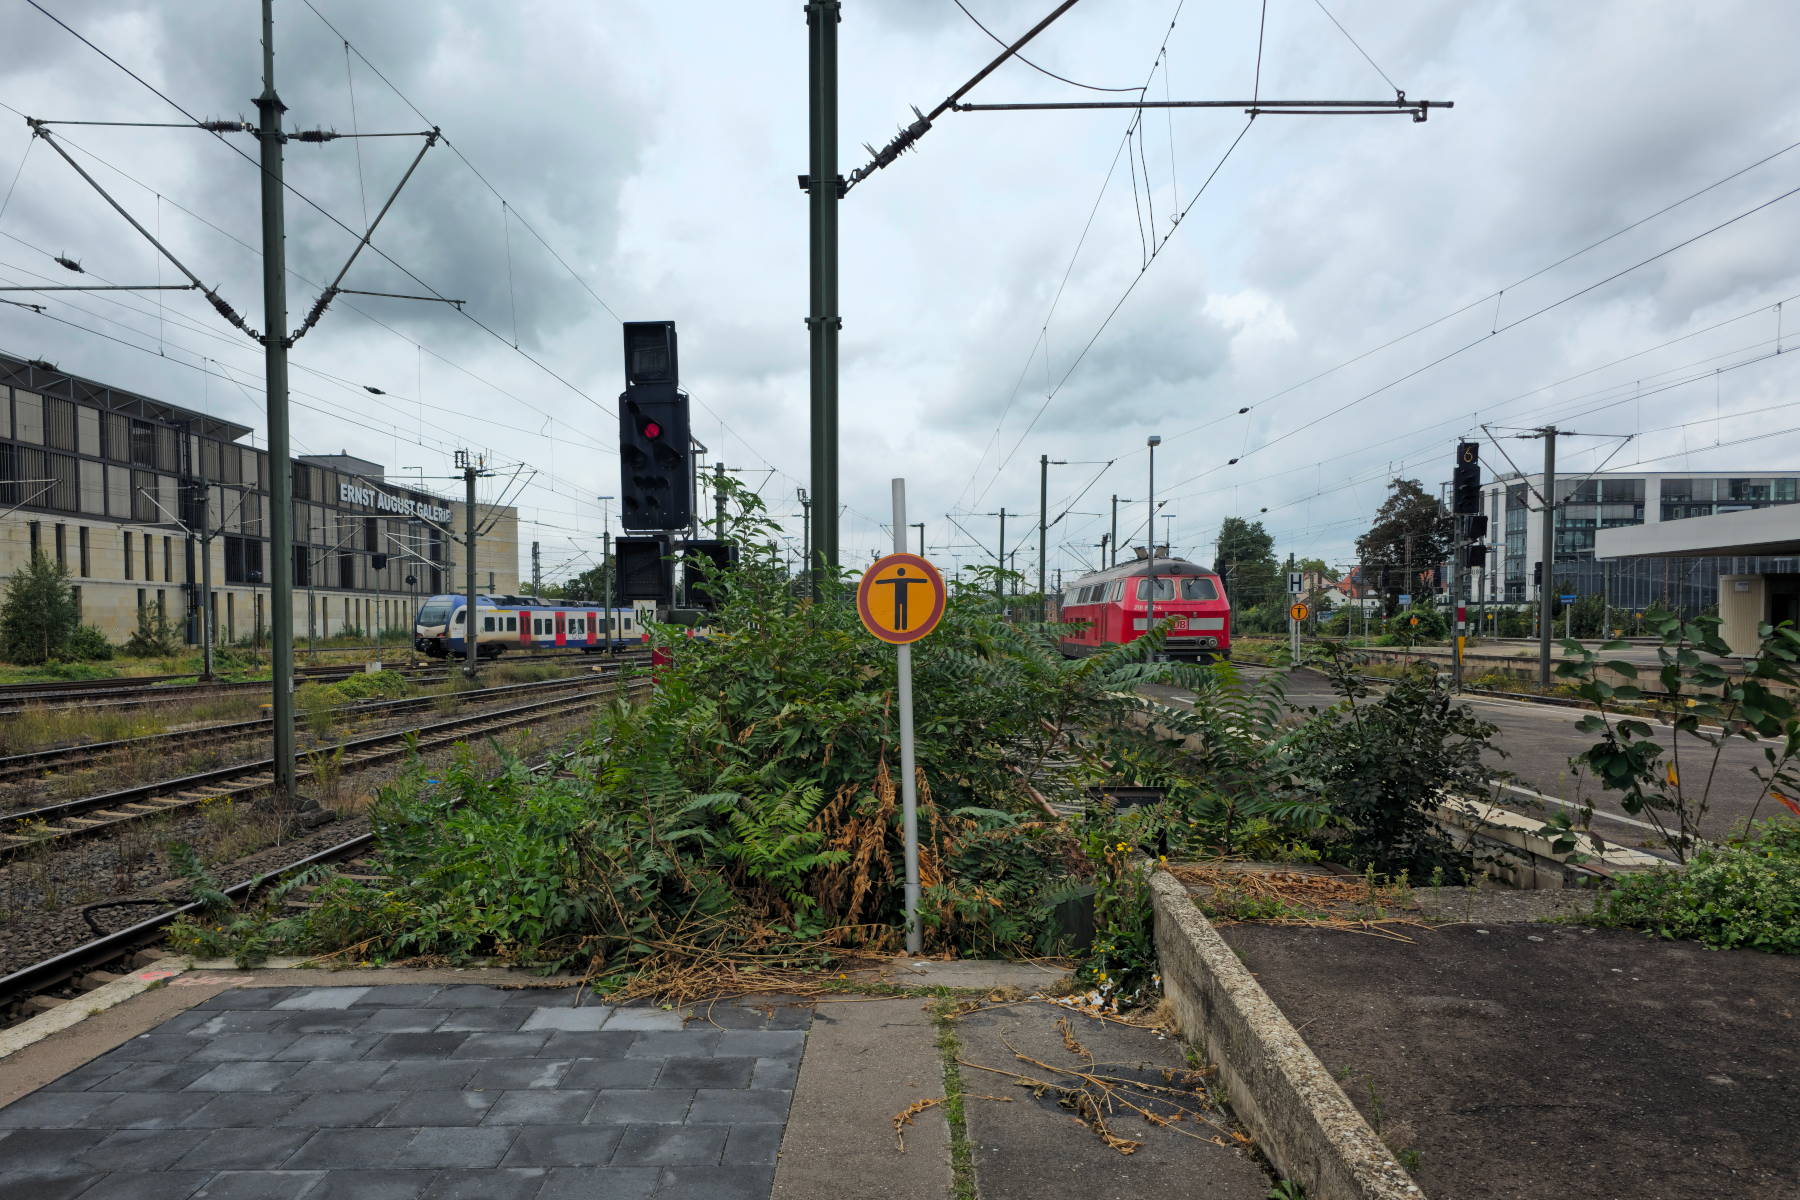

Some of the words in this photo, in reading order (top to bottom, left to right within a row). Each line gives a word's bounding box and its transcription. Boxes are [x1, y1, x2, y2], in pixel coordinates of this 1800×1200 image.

[1464, 446, 1473, 463] 6
[340, 483, 376, 508] ERNST
[377, 493, 416, 516] AUGUST
[416, 502, 453, 523] GALERIE
[1290, 574, 1302, 592] H
